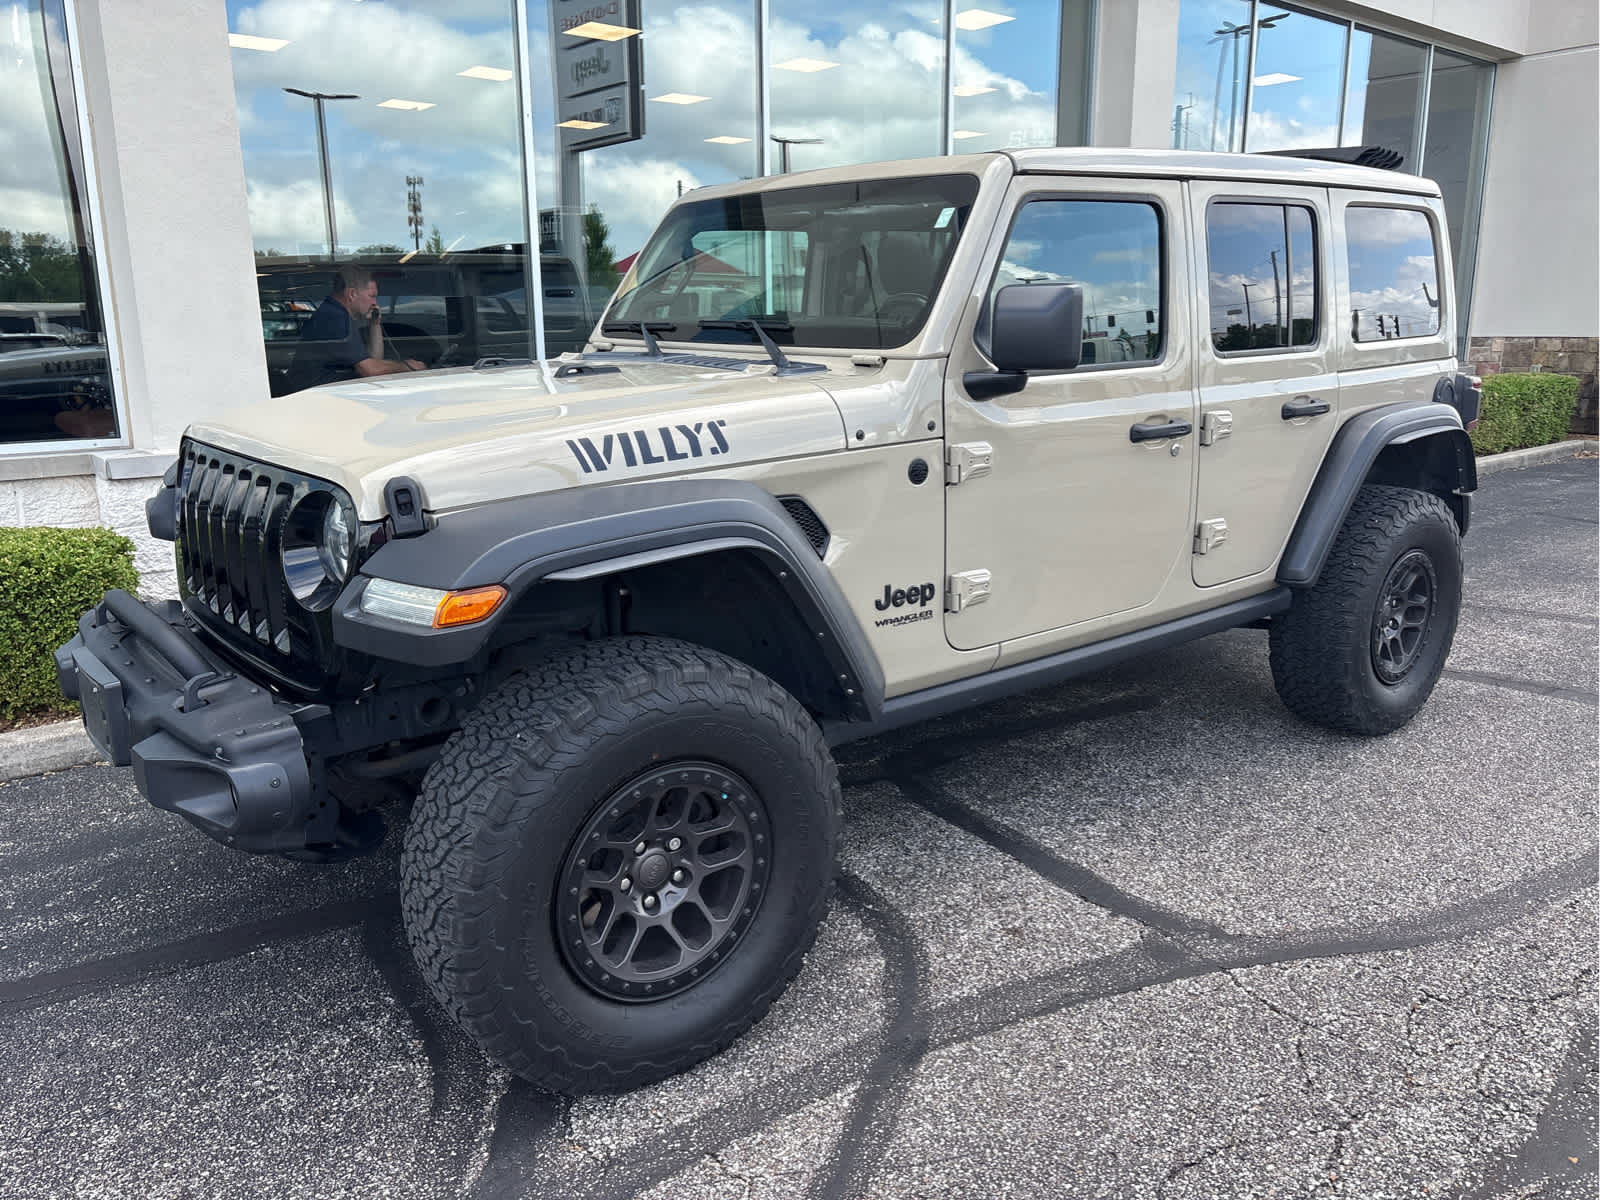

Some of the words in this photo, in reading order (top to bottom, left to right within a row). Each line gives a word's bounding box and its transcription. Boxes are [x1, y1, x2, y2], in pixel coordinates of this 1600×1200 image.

[566, 419, 729, 473] WILLYS
[875, 582, 935, 611] Jeep
[875, 610, 933, 627] WRANGLER
